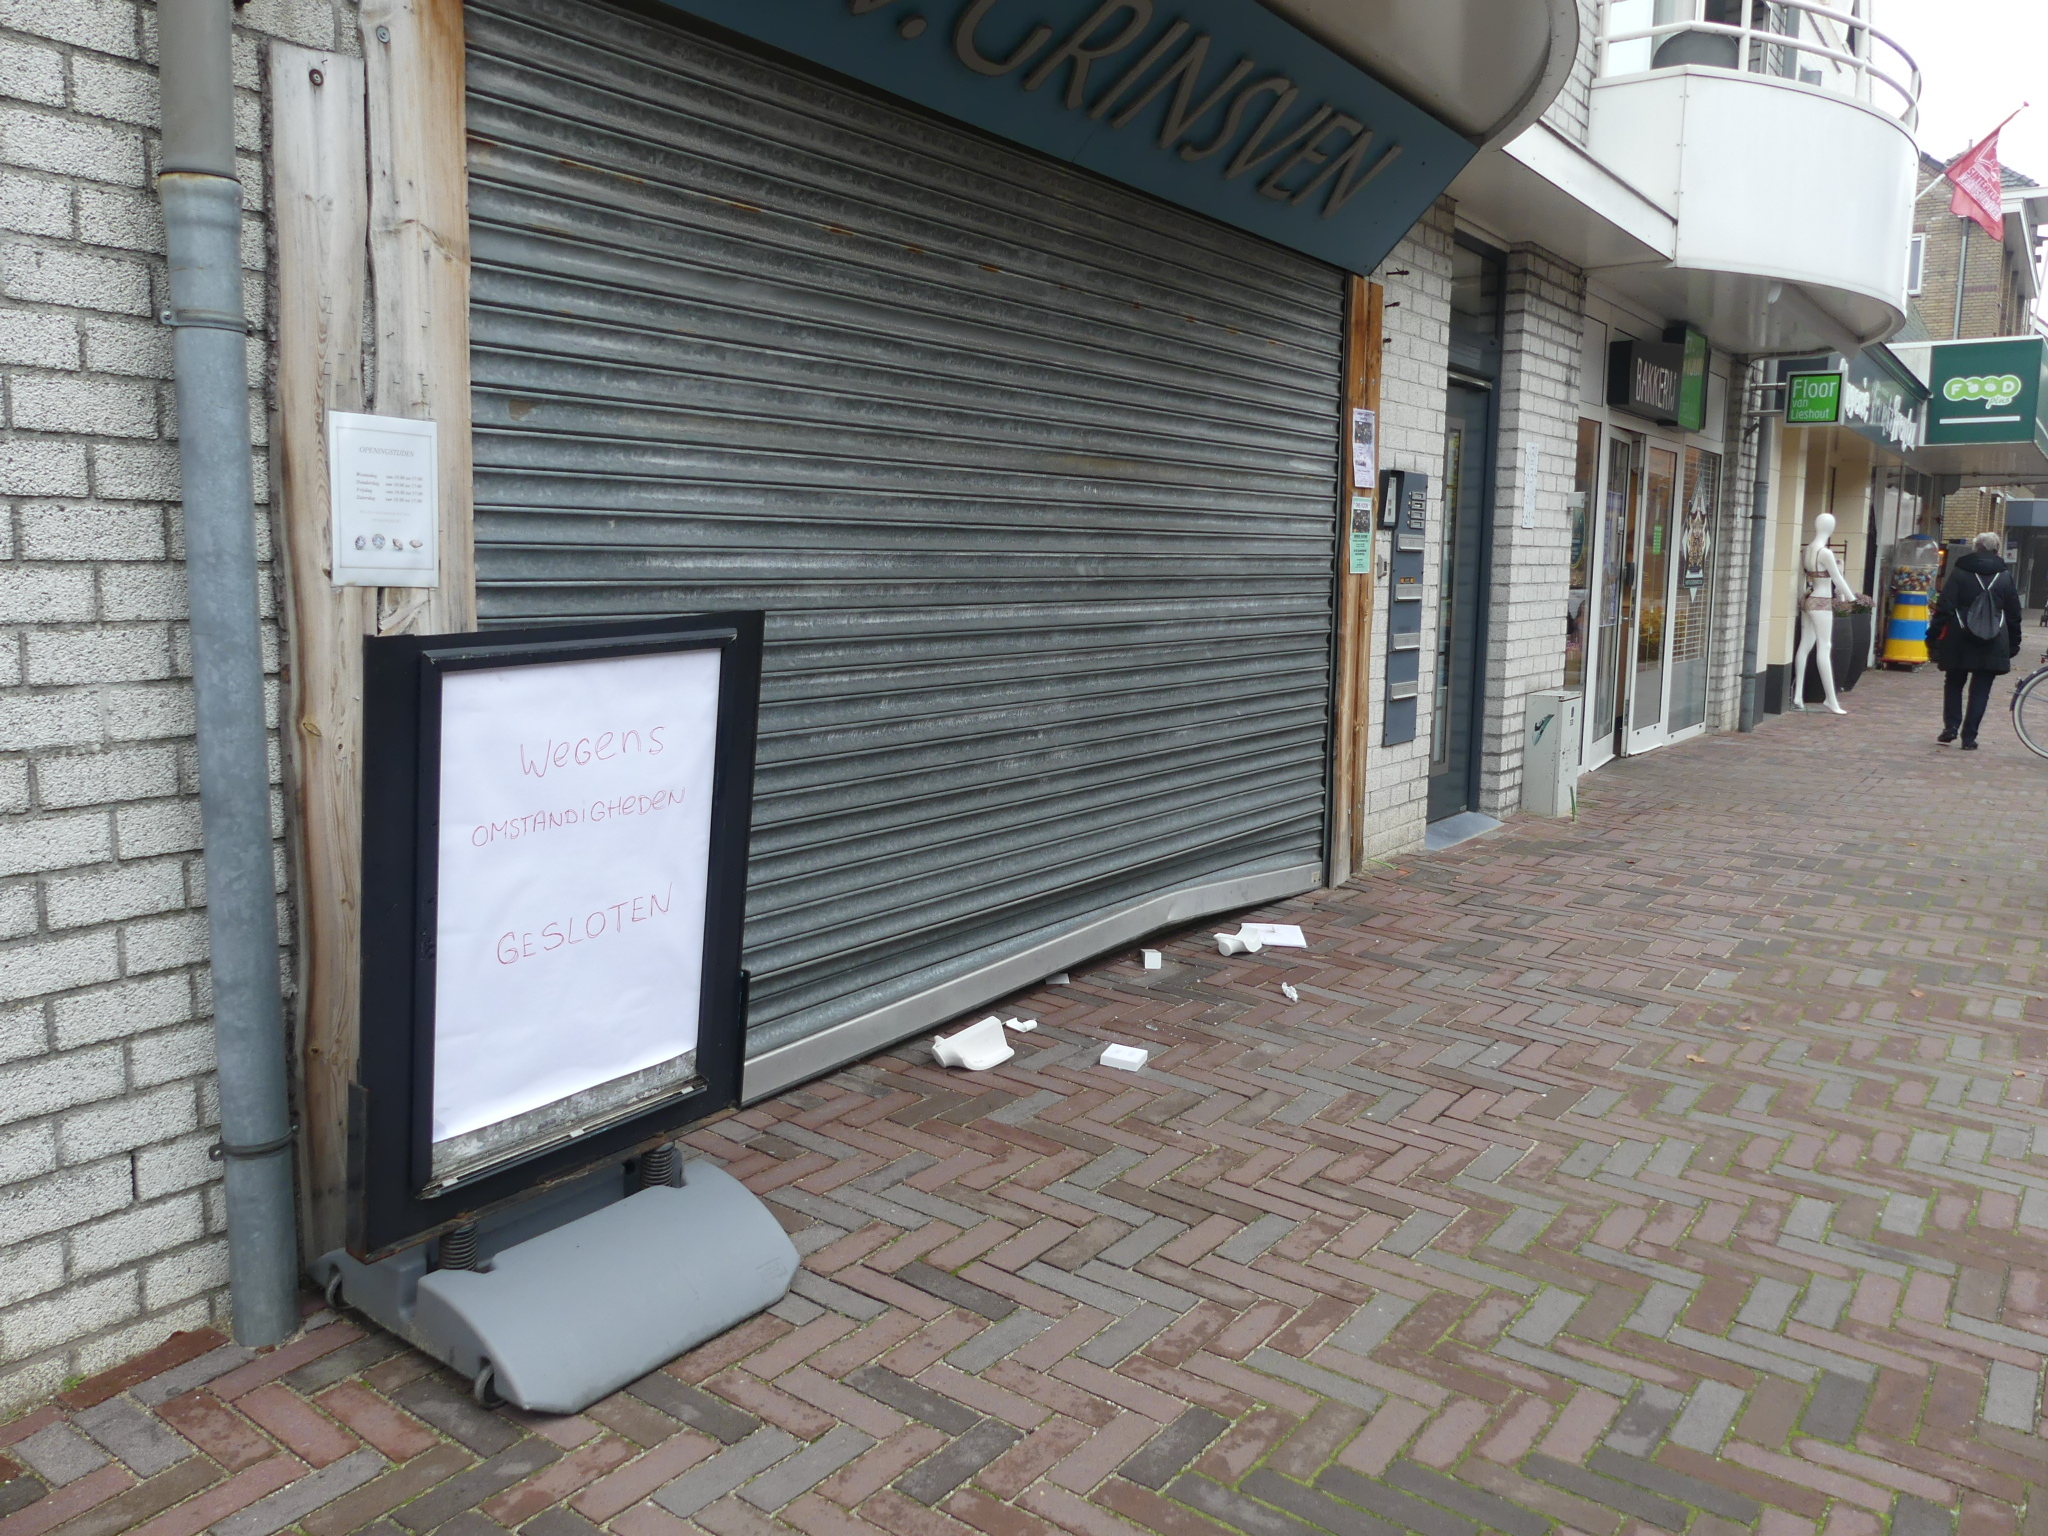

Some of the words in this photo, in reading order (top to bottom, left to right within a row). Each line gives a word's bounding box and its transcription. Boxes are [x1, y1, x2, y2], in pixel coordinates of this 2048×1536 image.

[952, 0, 1403, 219] GRINSVEN
[1635, 357, 1677, 411] BAKKERIJ
[1792, 378, 1837, 398] Floor
[1951, 380, 2015, 396] FOOD
[1792, 398, 1809, 408] van
[1790, 408, 1830, 420] Lieshout
[496, 882, 674, 966] GESLOTEN
